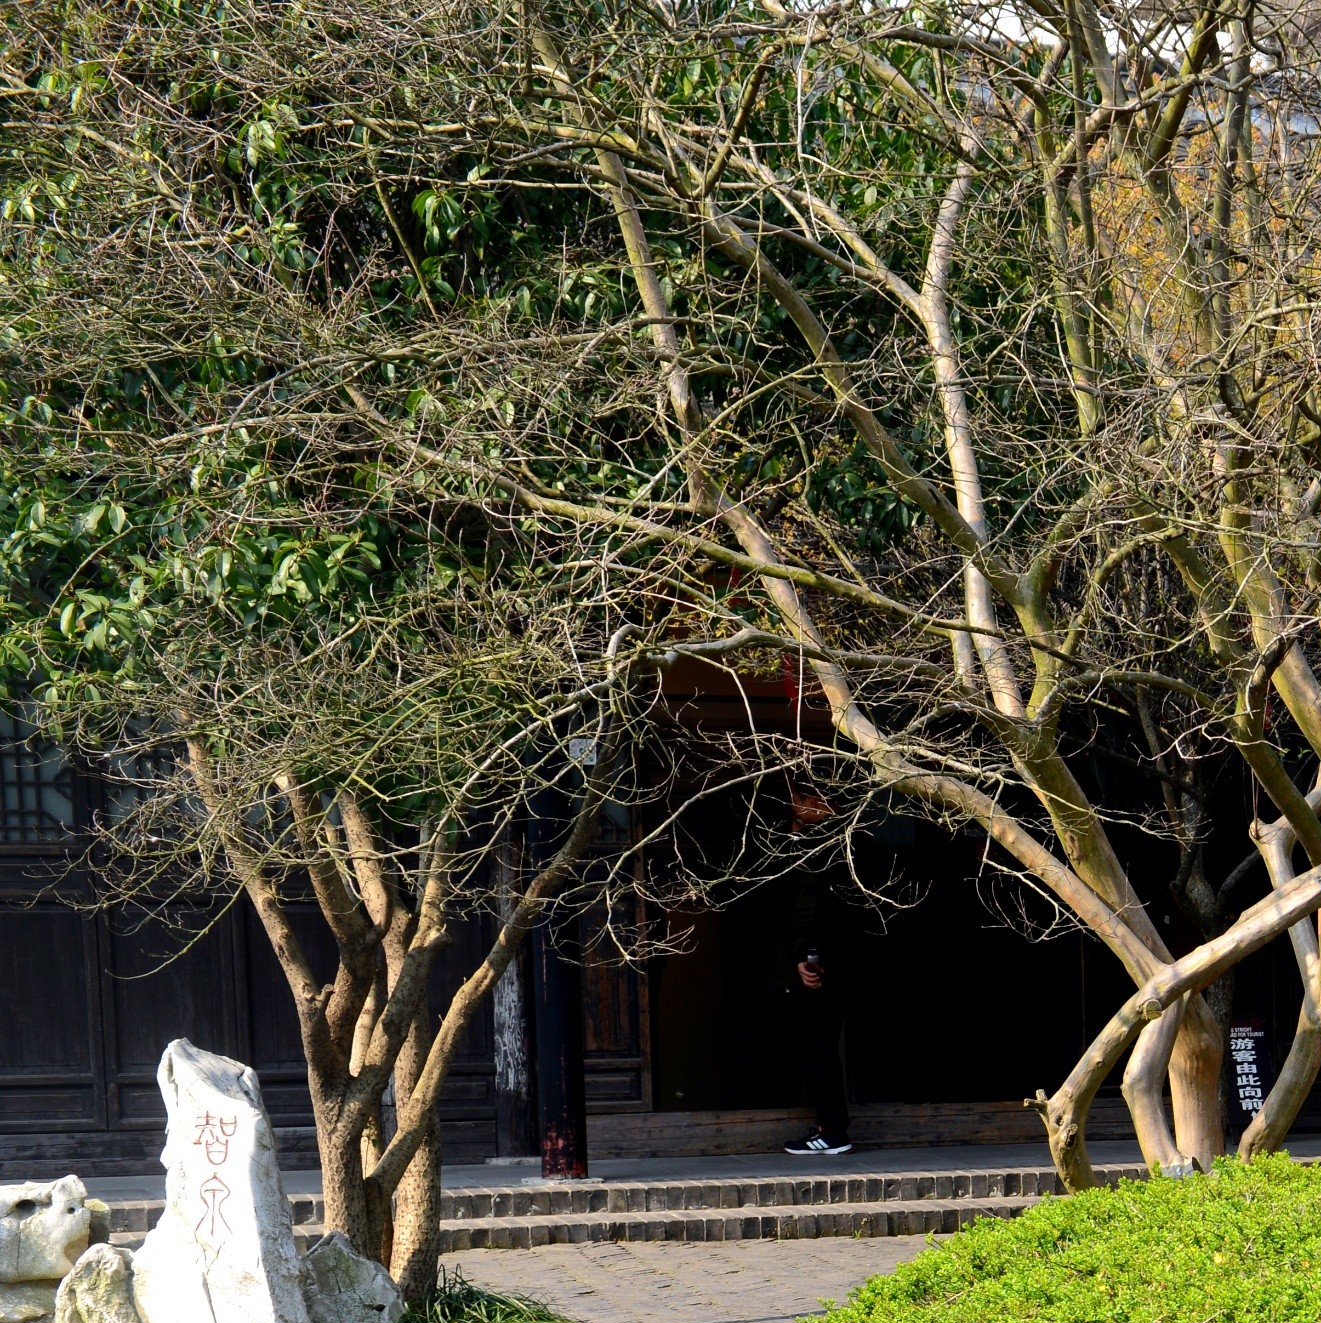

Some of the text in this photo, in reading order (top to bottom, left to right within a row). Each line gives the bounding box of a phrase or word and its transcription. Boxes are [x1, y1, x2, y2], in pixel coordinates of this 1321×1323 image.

[1230, 1038, 1264, 1120] 游客由此向前
